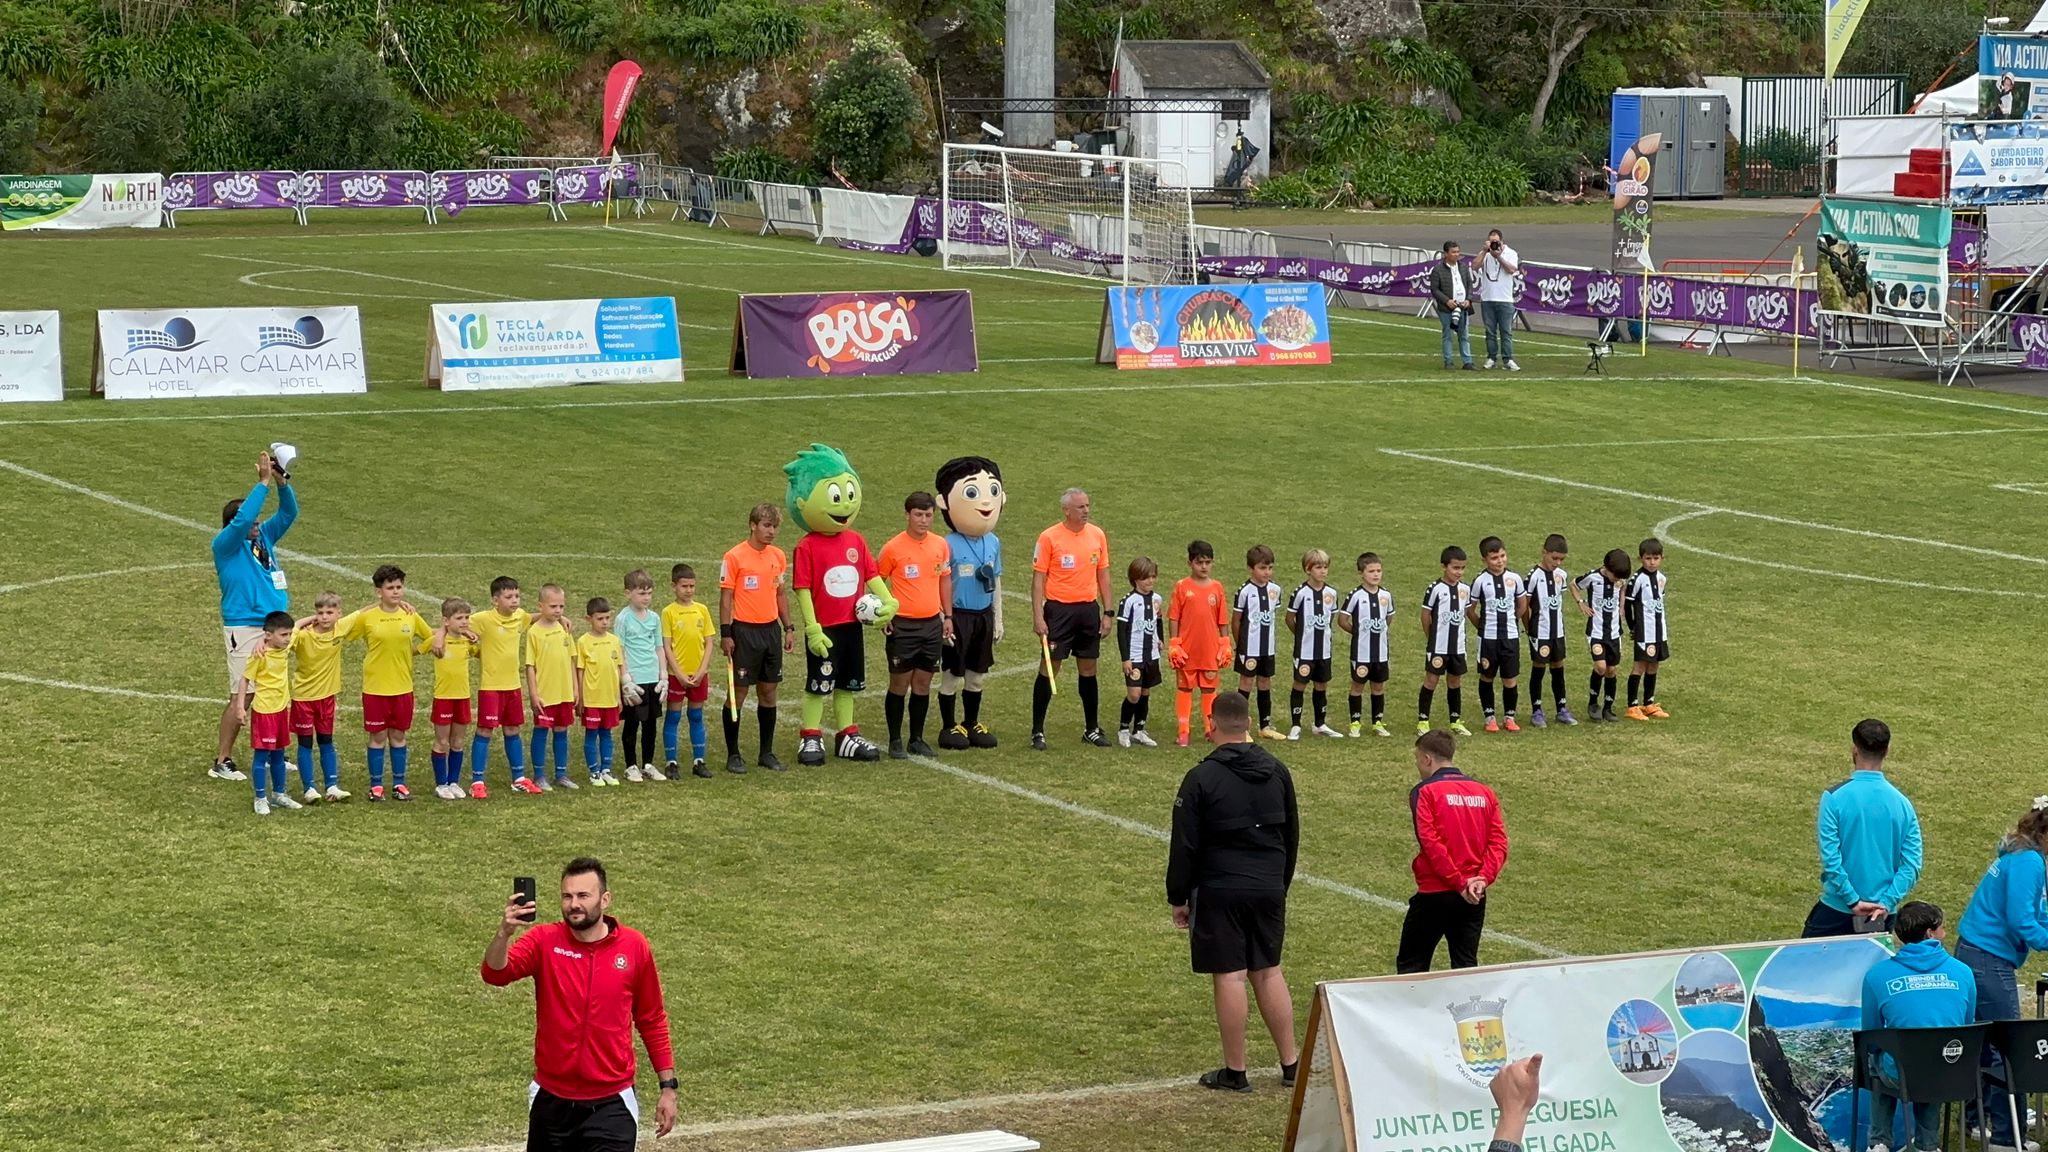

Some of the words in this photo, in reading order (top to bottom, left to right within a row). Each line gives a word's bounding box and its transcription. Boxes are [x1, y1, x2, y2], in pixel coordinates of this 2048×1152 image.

[1994, 43, 2012, 68] VIA
[1990, 148, 1996, 157] O
[1998, 147, 2044, 157] VERDADEIRO
[1990, 157, 2014, 167] SABOR
[2016, 157, 2026, 166] DO
[9, 180, 62, 190] JARDINAGEM
[102, 203, 157, 211] GARDENS
[1851, 209, 1893, 237] ACTIVA
[1894, 213, 1920, 240] COOL
[1178, 290, 1252, 325] CHURRASCARIA
[15, 323, 45, 335] LDA
[496, 320, 545, 331] TECLA
[497, 330, 584, 343] VANGUARDA
[498, 342, 588, 352] teclavanguarda.pt
[849, 340, 903, 363] MARACUJÁ
[1180, 343, 1222, 358] BRASA
[1225, 343, 1258, 357] VIVA
[109, 355, 229, 376] CALAMAR
[240, 352, 358, 373] CALAMAR
[463, 357, 537, 367] SOLUÇÕES
[592, 368, 610, 377] 924
[613, 367, 632, 376] 047
[636, 366, 654, 375] 484
[148, 379, 194, 392] HOTEL
[279, 376, 323, 389] HOTEL
[1463, 795, 1486, 808] YOUTH
[1908, 975, 1936, 983] BRINDE
[1456, 1063, 1473, 1083] PONTA
[1373, 1113, 1448, 1139] JUNTA
[1452, 1109, 1484, 1132] DE
